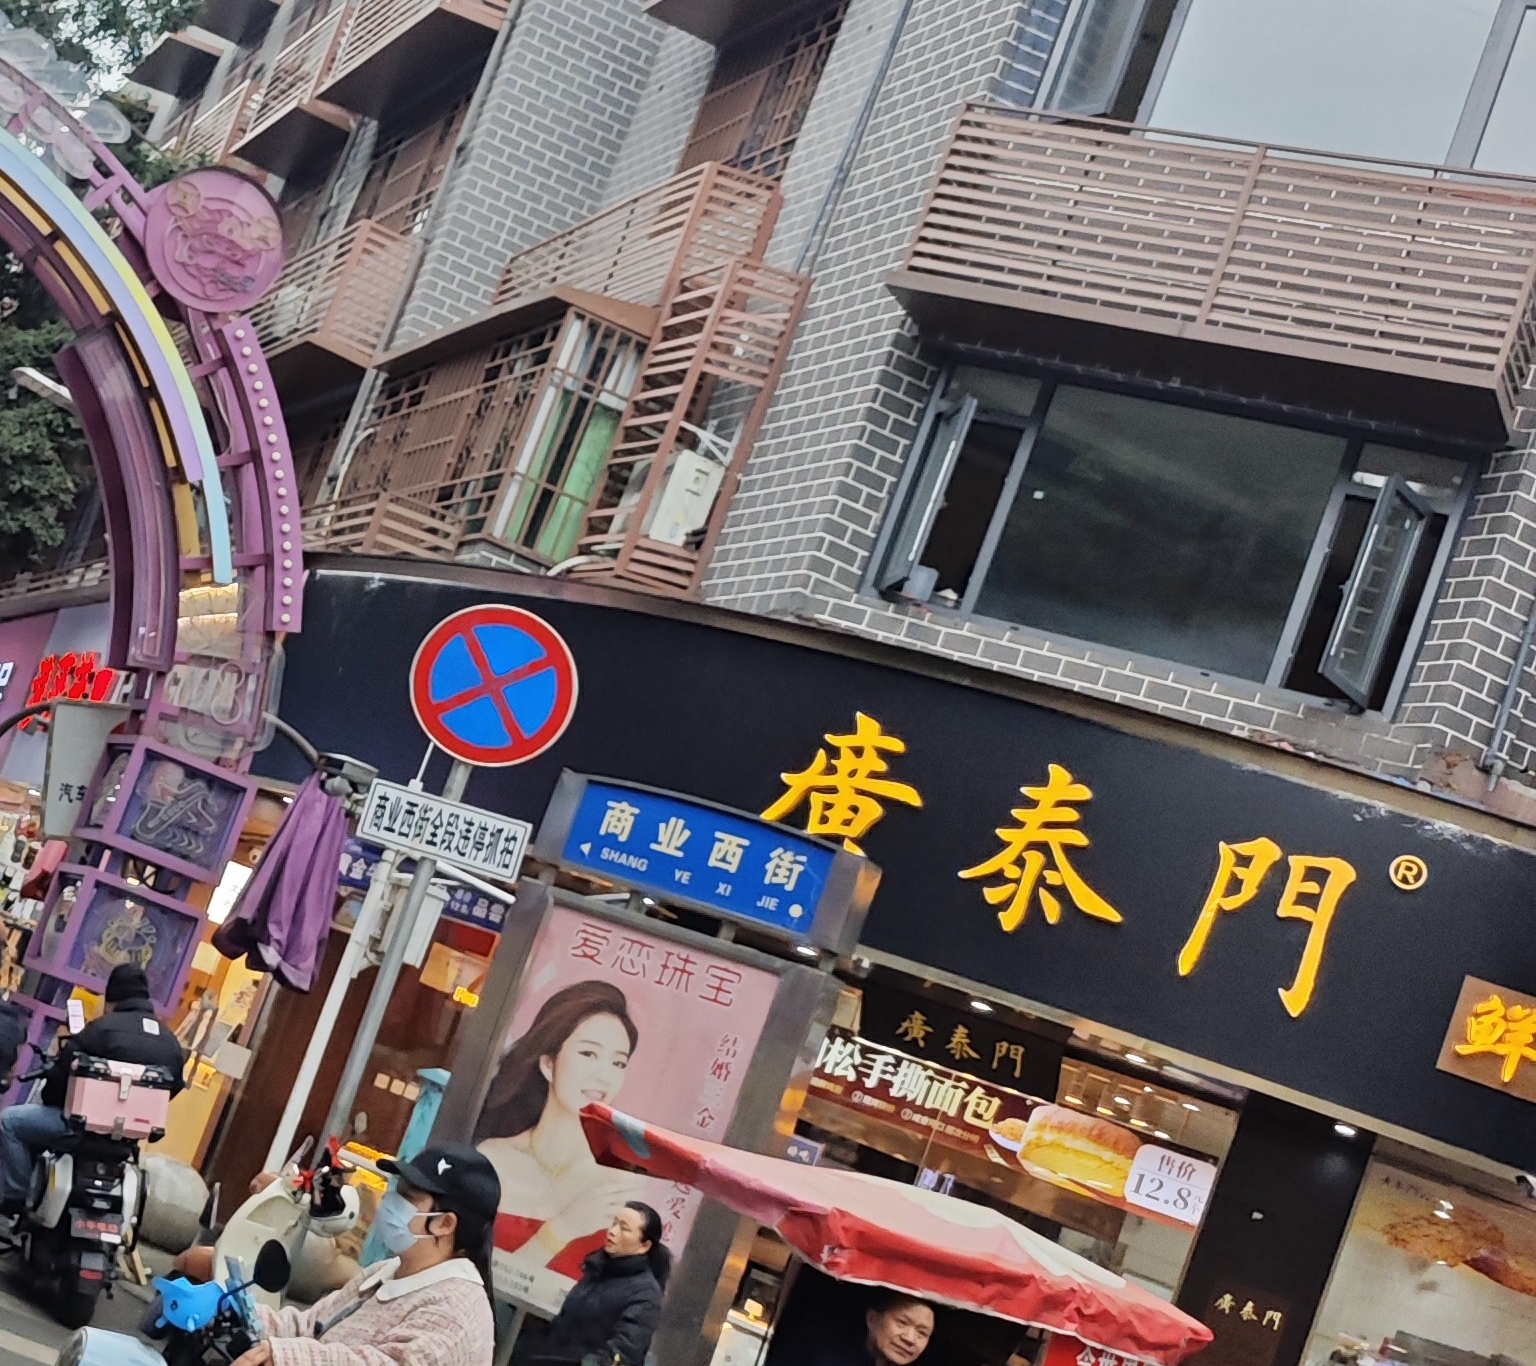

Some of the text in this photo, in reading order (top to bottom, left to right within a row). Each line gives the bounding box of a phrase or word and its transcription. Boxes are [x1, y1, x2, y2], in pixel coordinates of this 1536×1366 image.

[369, 791, 519, 870] 商业西街全段违停抓拍
[599, 800, 808, 892] 商业西街
[600, 847, 780, 912] SHANG YE XI JIE
[571, 922, 742, 1007] 爱恋珠宝
[695, 1033, 739, 1130] 结婚金
[815, 1036, 1002, 1130] 松手撕面包
[895, 1010, 1026, 1078] 廣泰門
[1130, 1173, 1192, 1211] 12.8
